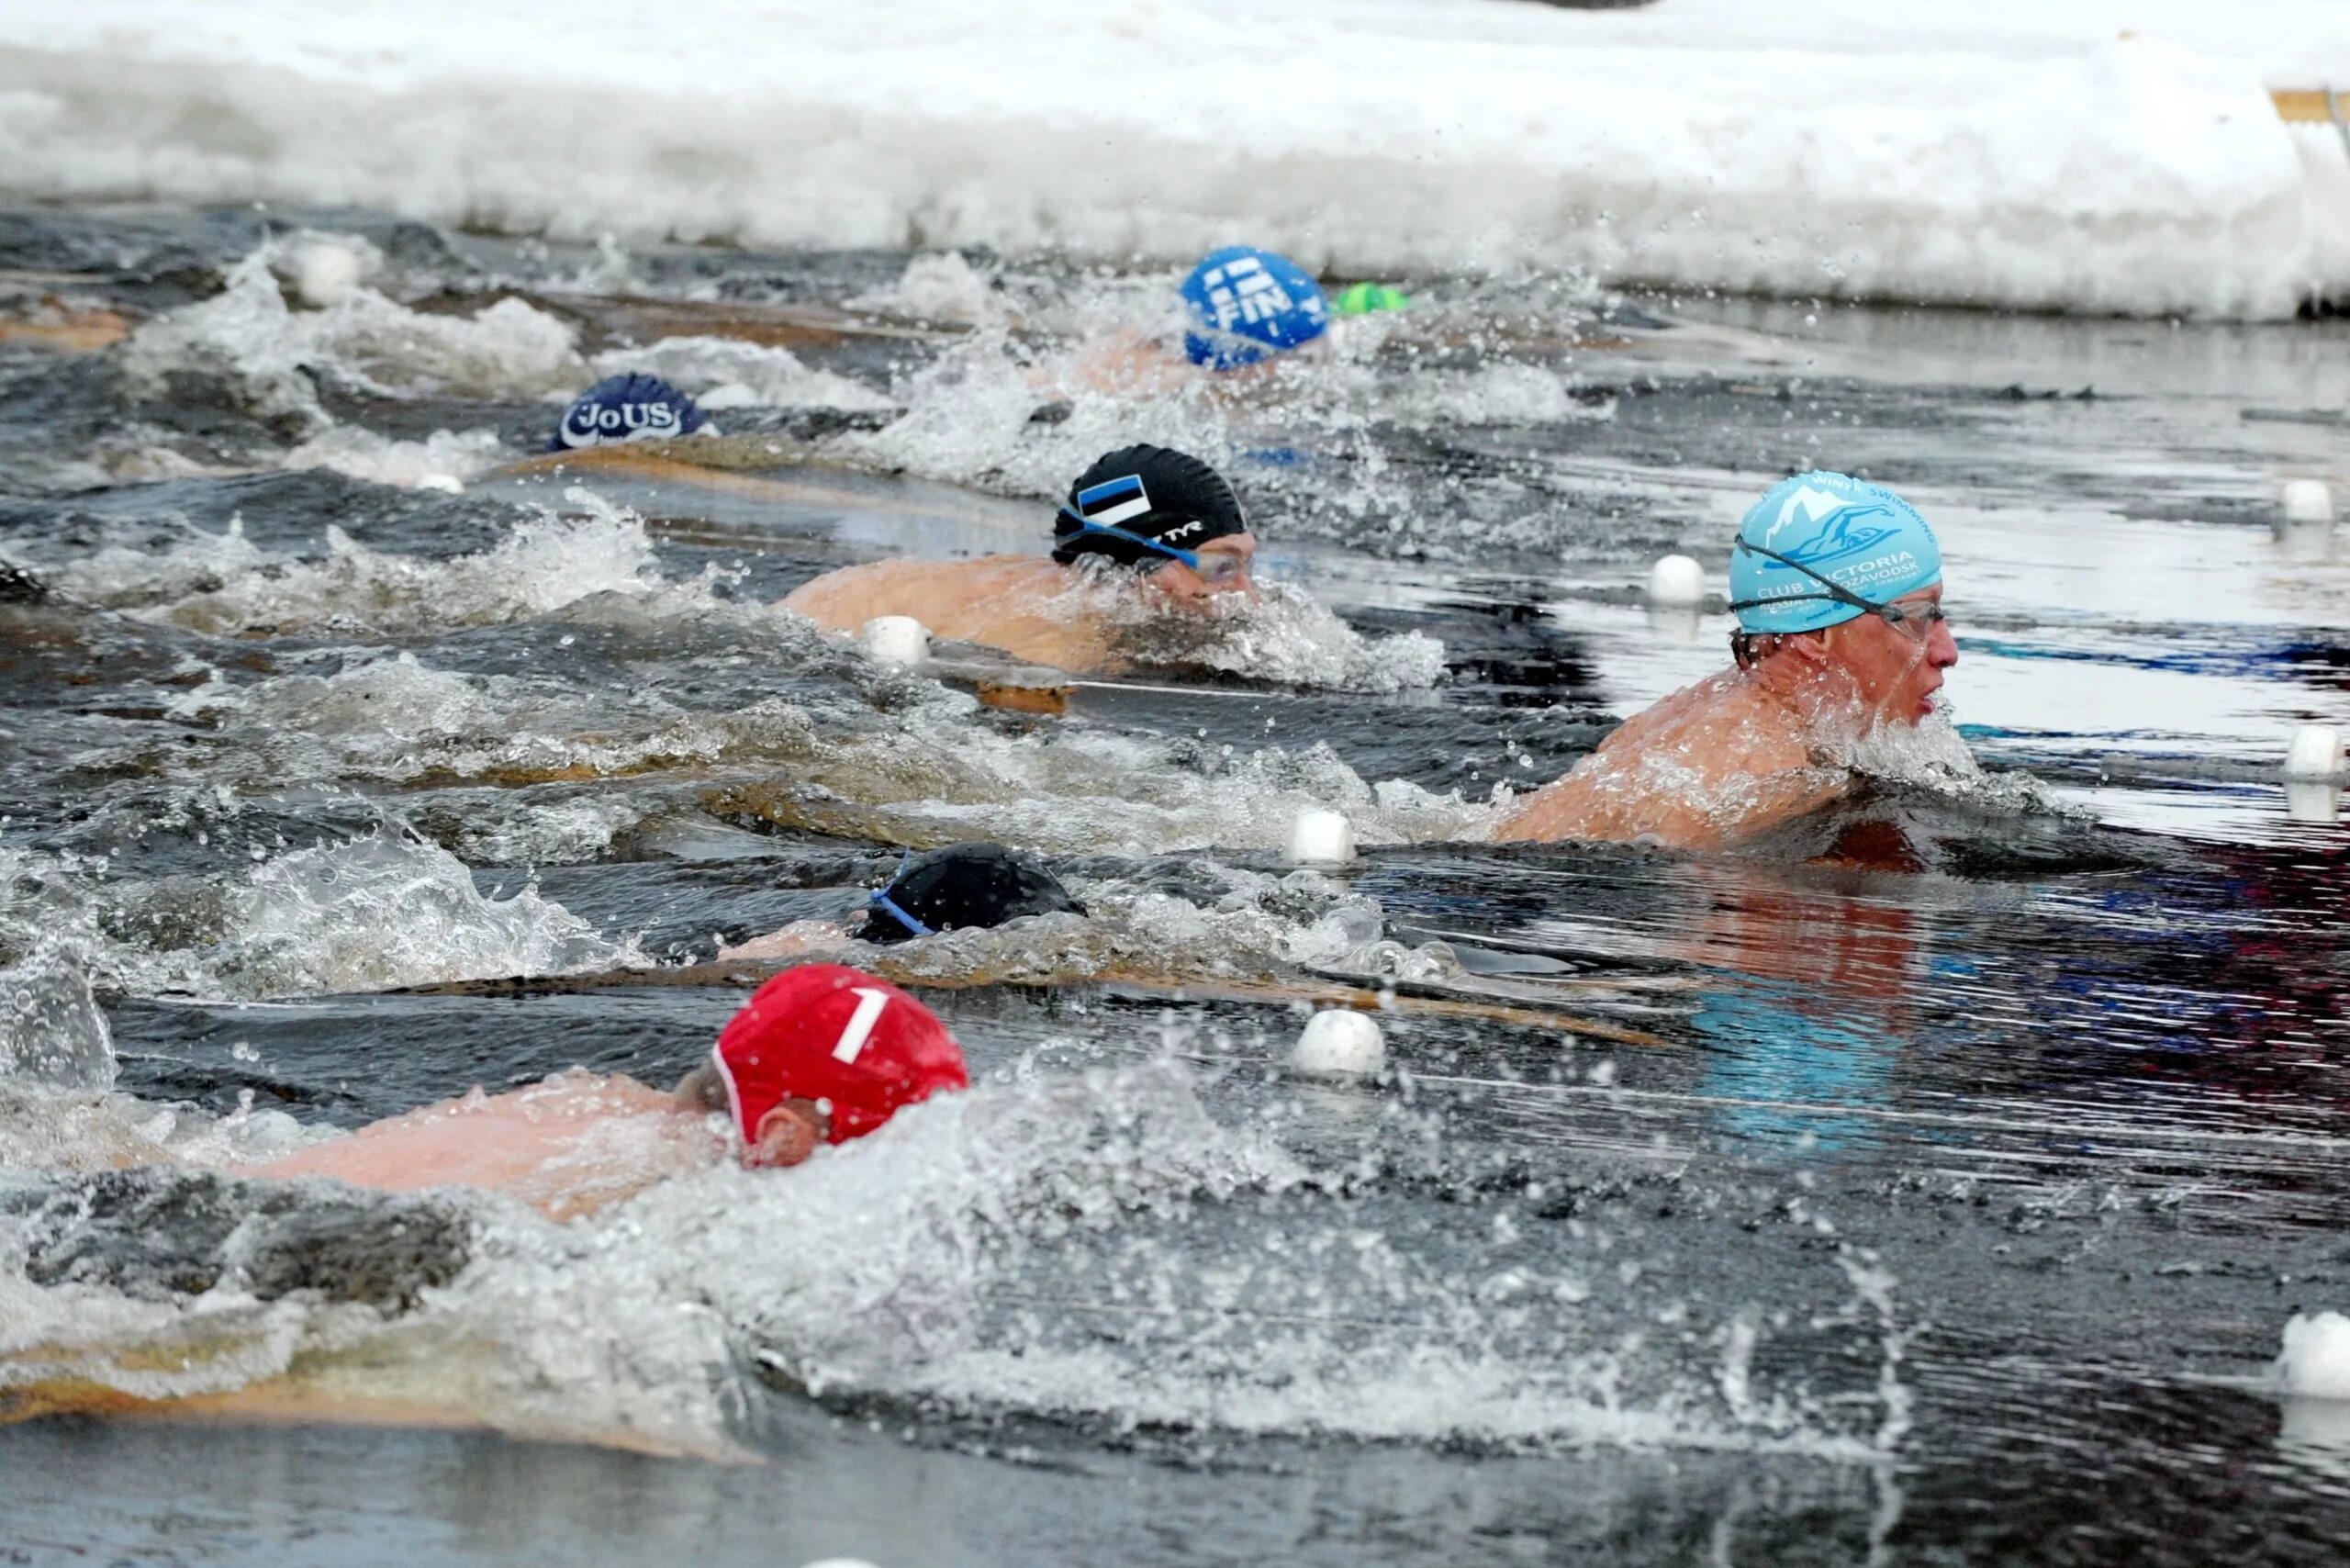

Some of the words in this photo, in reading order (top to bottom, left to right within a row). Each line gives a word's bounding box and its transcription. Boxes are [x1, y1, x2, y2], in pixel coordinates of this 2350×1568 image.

[1214, 285, 1293, 331] FIN
[1164, 520, 1203, 542] TYR
[1869, 487, 1935, 543] SWIMMING
[1757, 582, 1805, 599] CLUB
[832, 987, 890, 1066] 1
